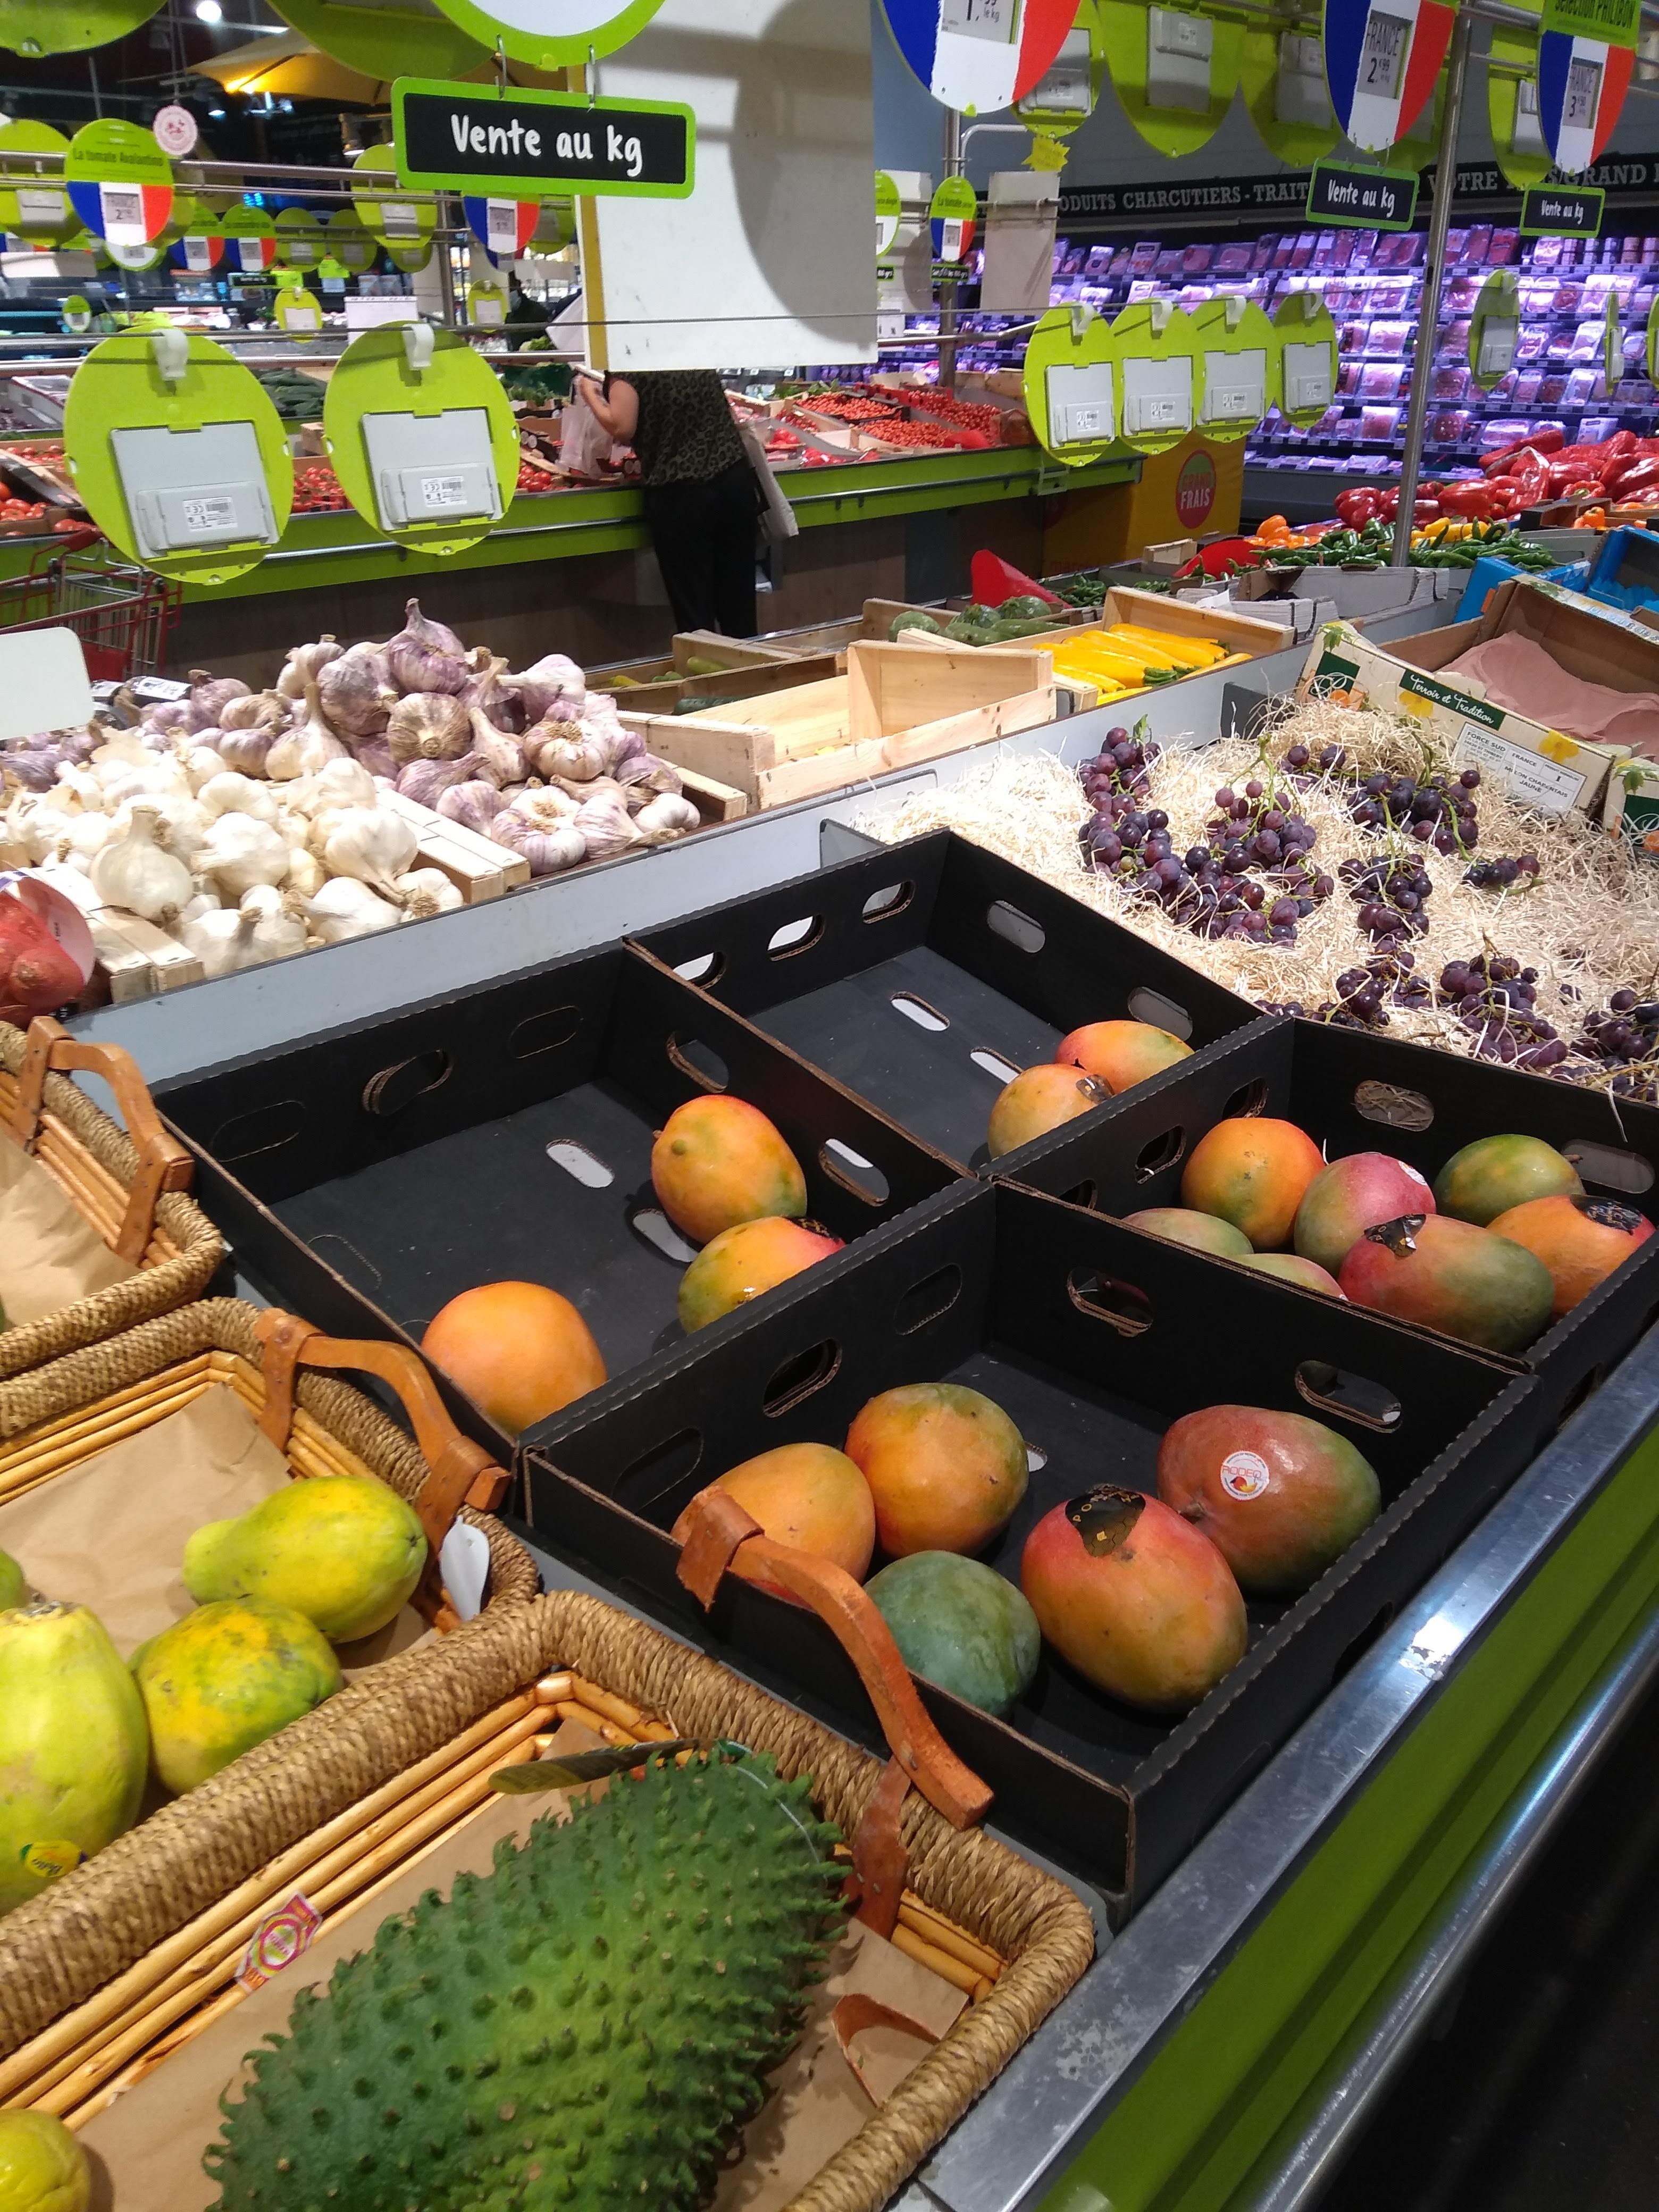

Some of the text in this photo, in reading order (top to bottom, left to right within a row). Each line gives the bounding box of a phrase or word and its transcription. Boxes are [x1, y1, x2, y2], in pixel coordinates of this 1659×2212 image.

[1364, 21, 1401, 56] FRANCE
[450, 113, 643, 178] Vente au kg
[1428, 171, 1498, 191] VTRE
[1058, 193, 1116, 212] ODUITS
[1122, 186, 1242, 209] CHARCUTIERS
[1253, 182, 1310, 203] TRAIT
[1328, 179, 1396, 218] Vente au kg
[1541, 199, 1585, 225] Vente au kg
[1180, 488, 1210, 510] FRAIS
[1410, 674, 1495, 724] Terroir et Tradition
[1467, 731, 1506, 752] FORCE SUD
[1512, 753, 1537, 767] FRANCE
[1519, 780, 1543, 793] JAUNE
[1222, 1465, 1262, 1480] RODEO
